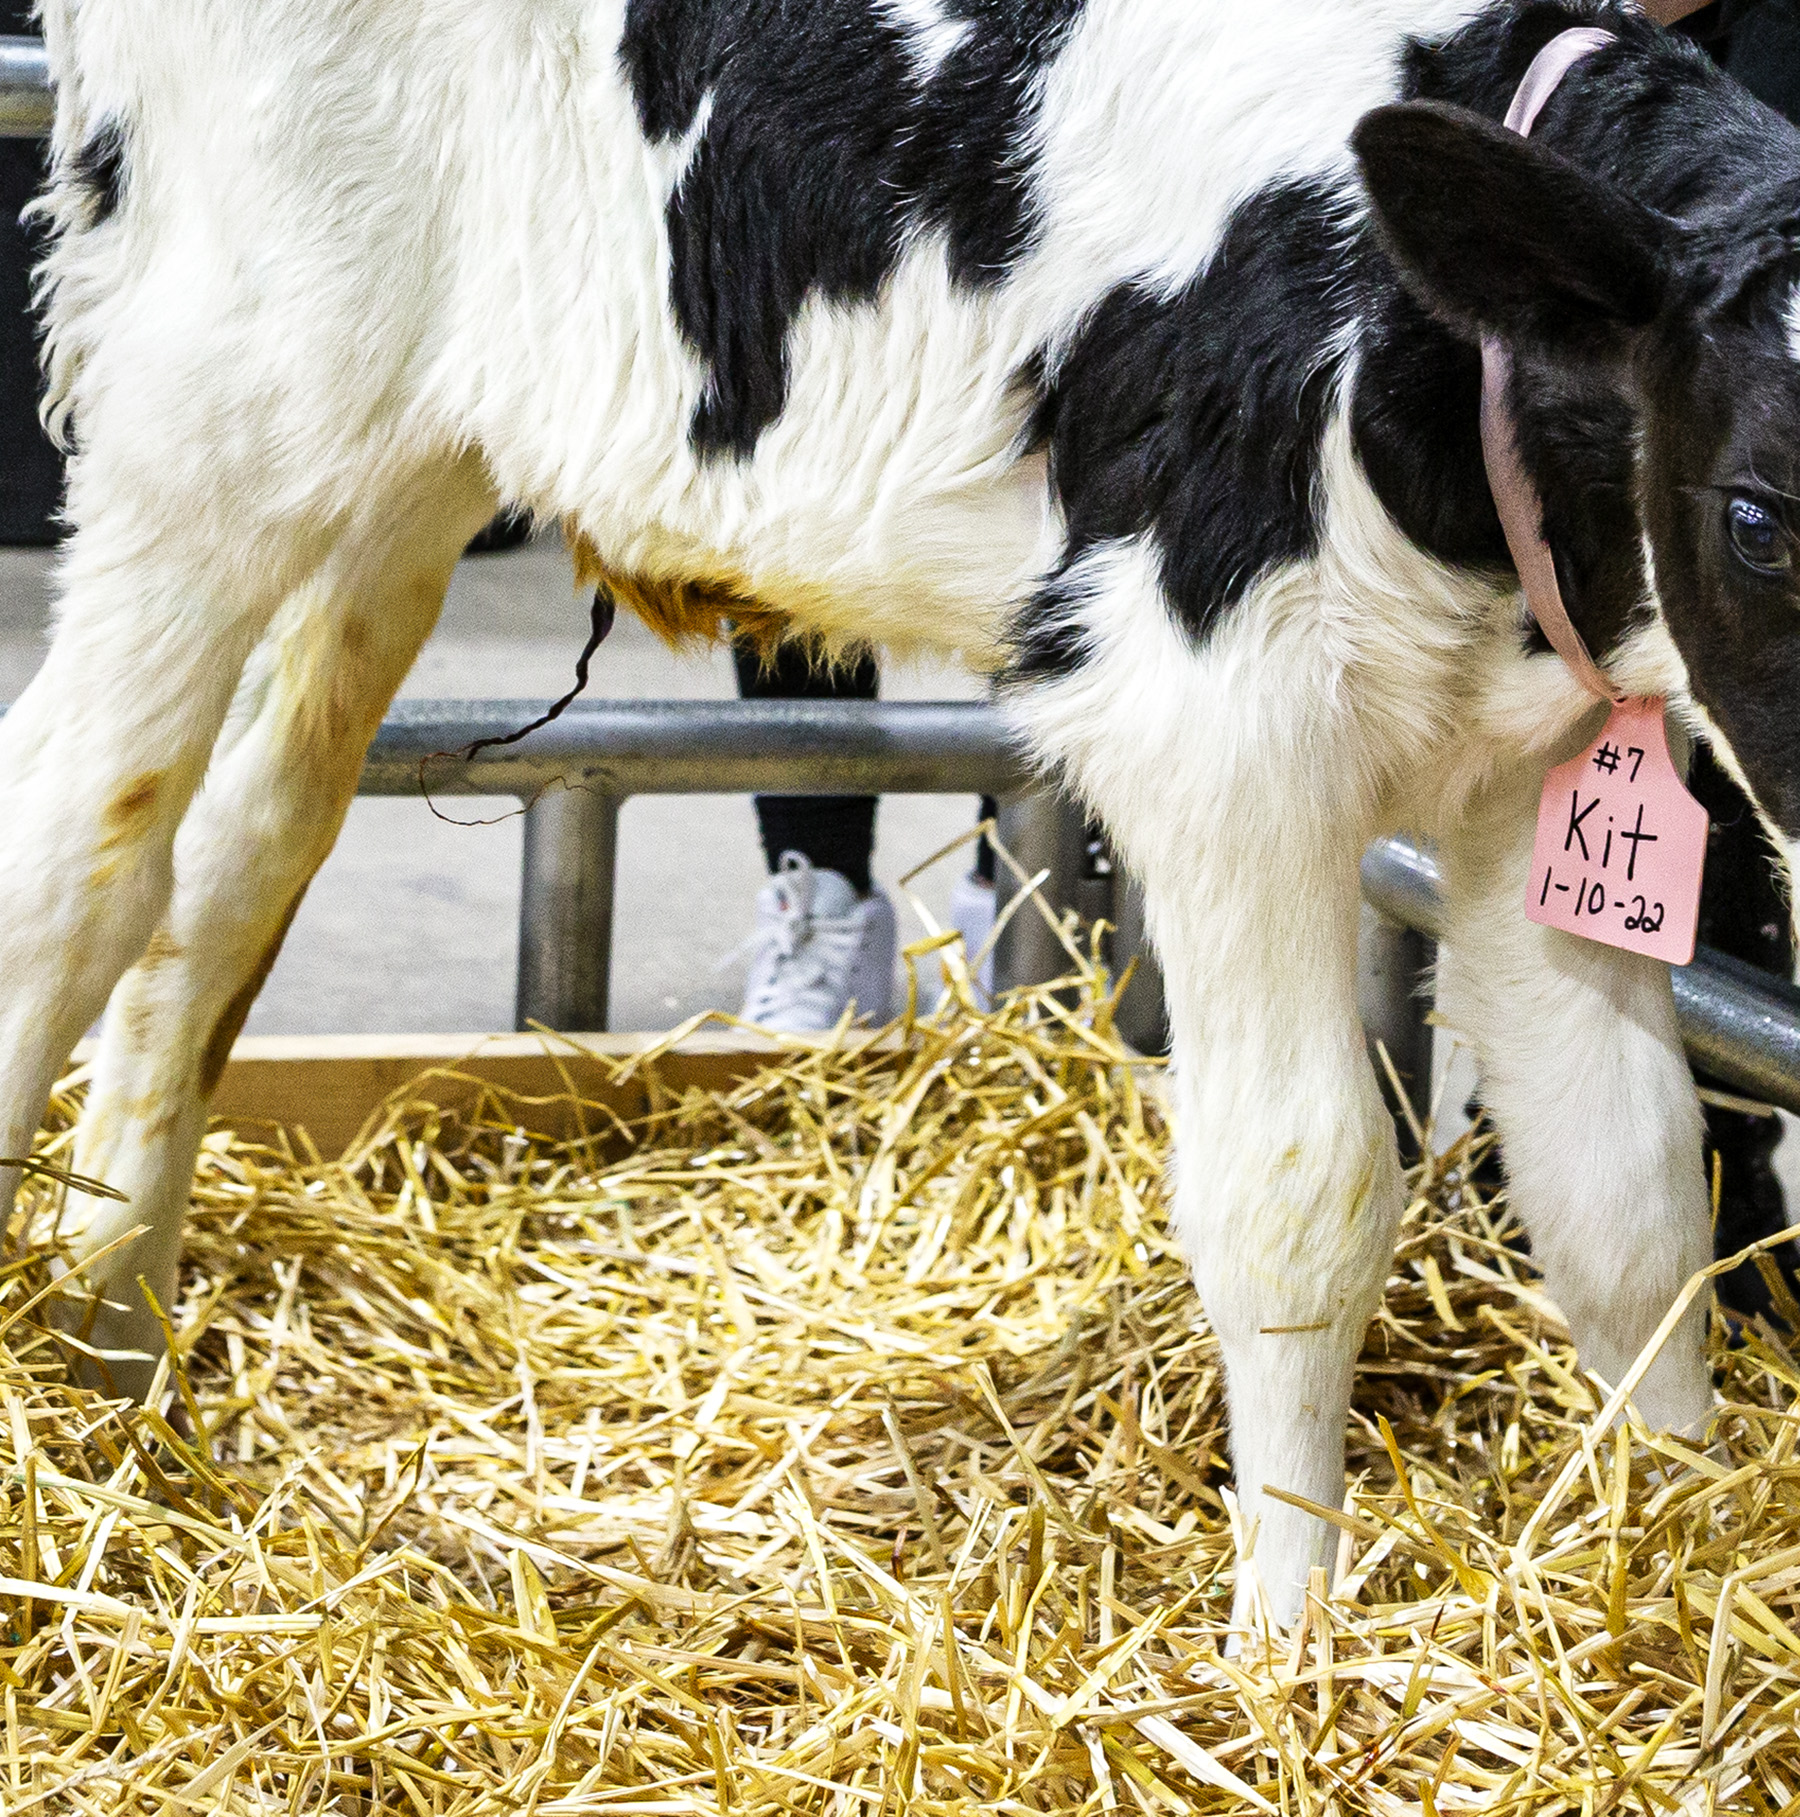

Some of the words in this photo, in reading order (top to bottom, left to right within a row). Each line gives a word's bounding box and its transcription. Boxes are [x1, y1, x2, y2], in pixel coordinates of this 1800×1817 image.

[1592, 741, 1644, 782] #7
[1565, 790, 1658, 880] Kit
[1540, 866, 1664, 932] 1-10-22
